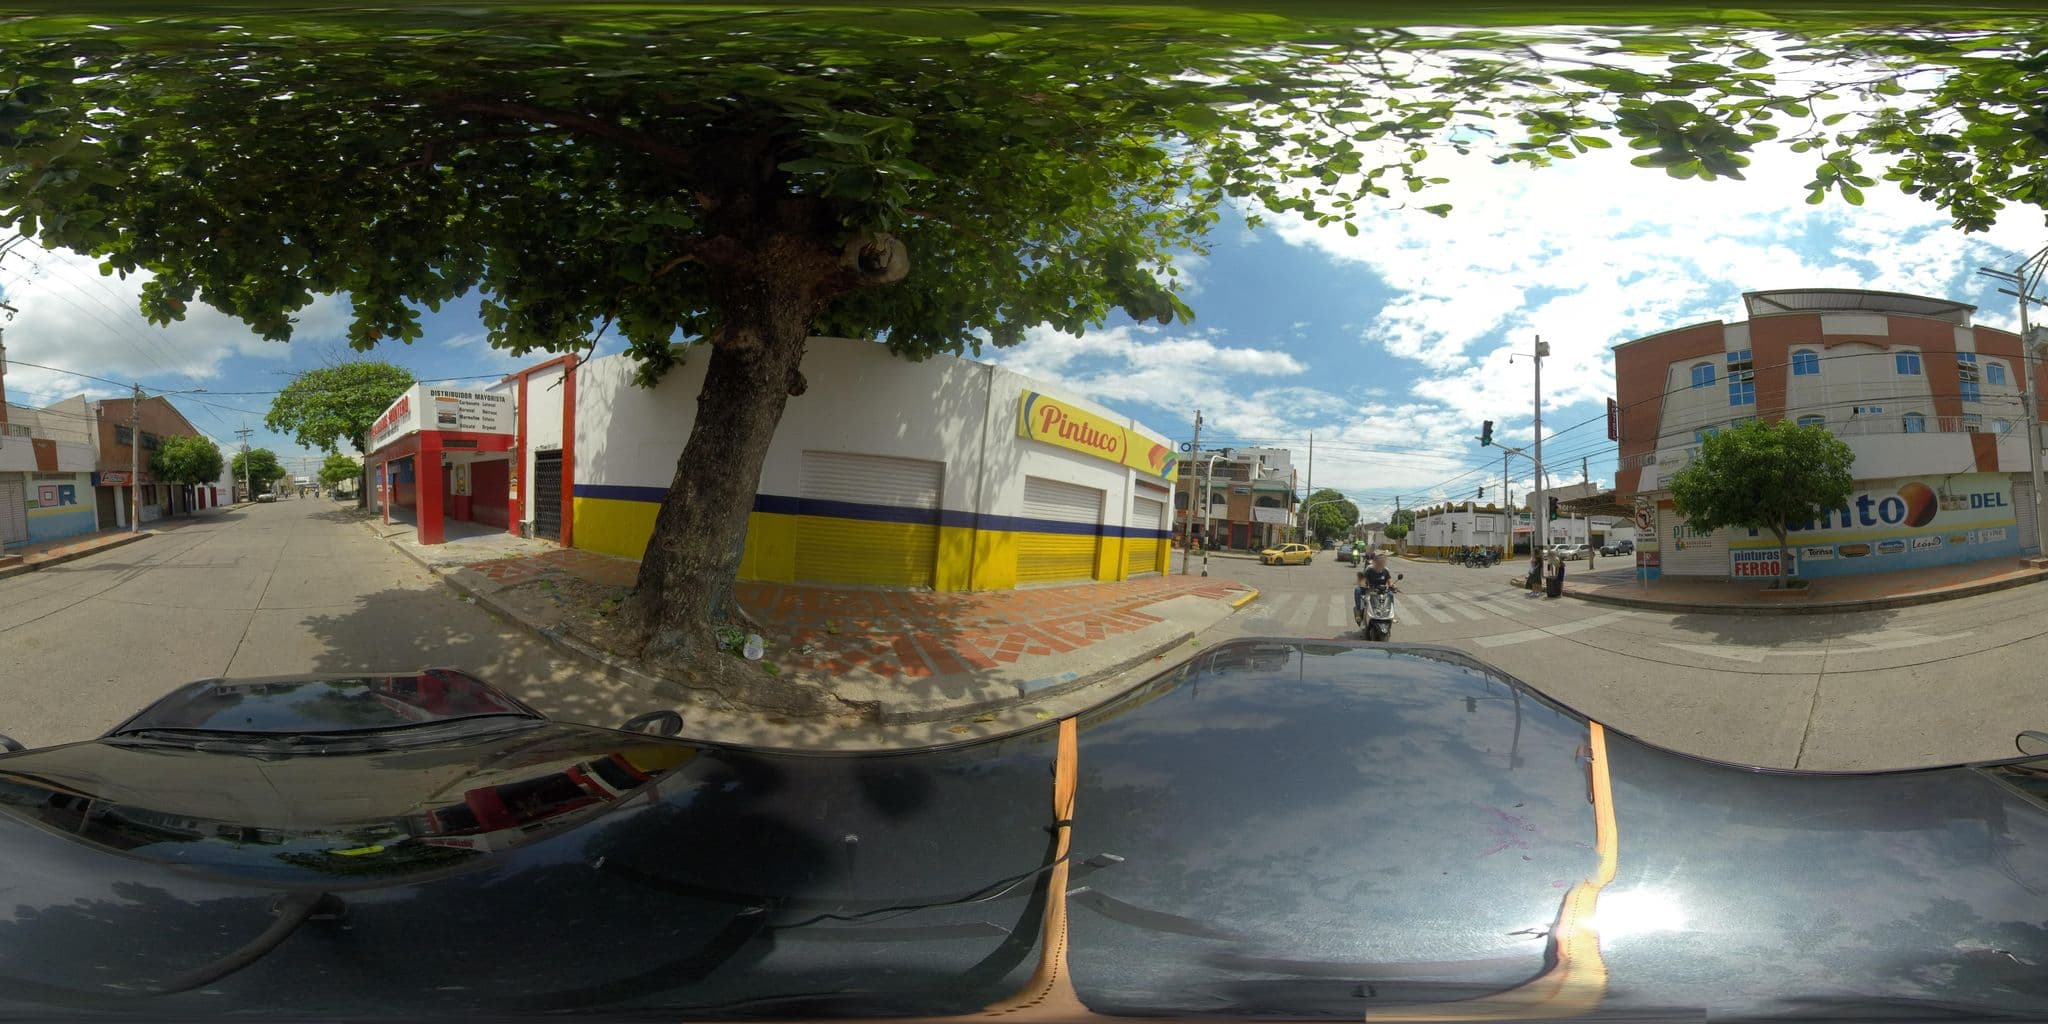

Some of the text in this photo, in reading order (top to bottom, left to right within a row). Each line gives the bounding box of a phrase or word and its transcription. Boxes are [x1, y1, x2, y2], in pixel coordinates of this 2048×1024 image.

[430, 389, 506, 403] DISTRIBUIDOR MAYORISTA
[1039, 405, 1118, 452] Pintuco
[1970, 492, 2008, 508] DEL
[1734, 550, 1780, 561] pinturas
[1735, 561, 1780, 576] FERRO
